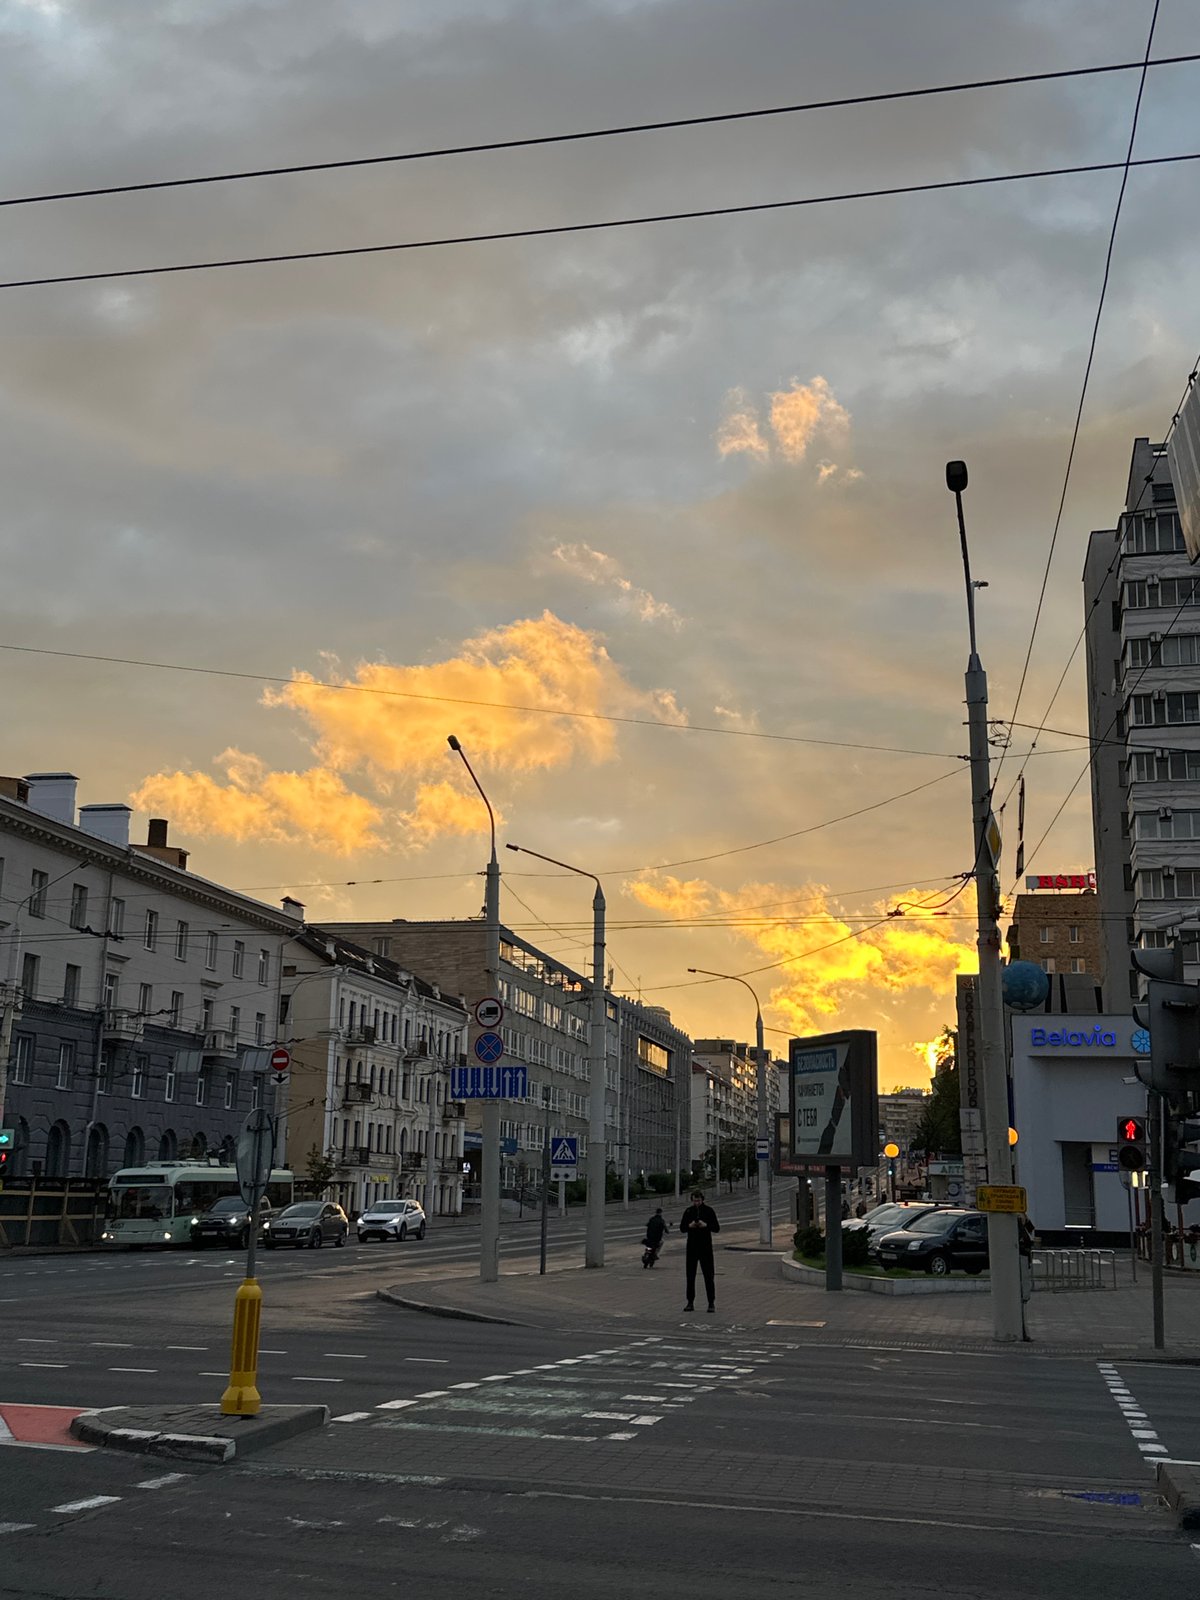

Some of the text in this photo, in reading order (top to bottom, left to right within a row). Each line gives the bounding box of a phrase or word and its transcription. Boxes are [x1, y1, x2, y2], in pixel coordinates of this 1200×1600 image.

[1031, 1024, 1117, 1047] Belavia
[797, 1053, 834, 1071] БЕЗОПАСНОСТЬ
[797, 1107, 817, 1127] С ТЕБЯ
